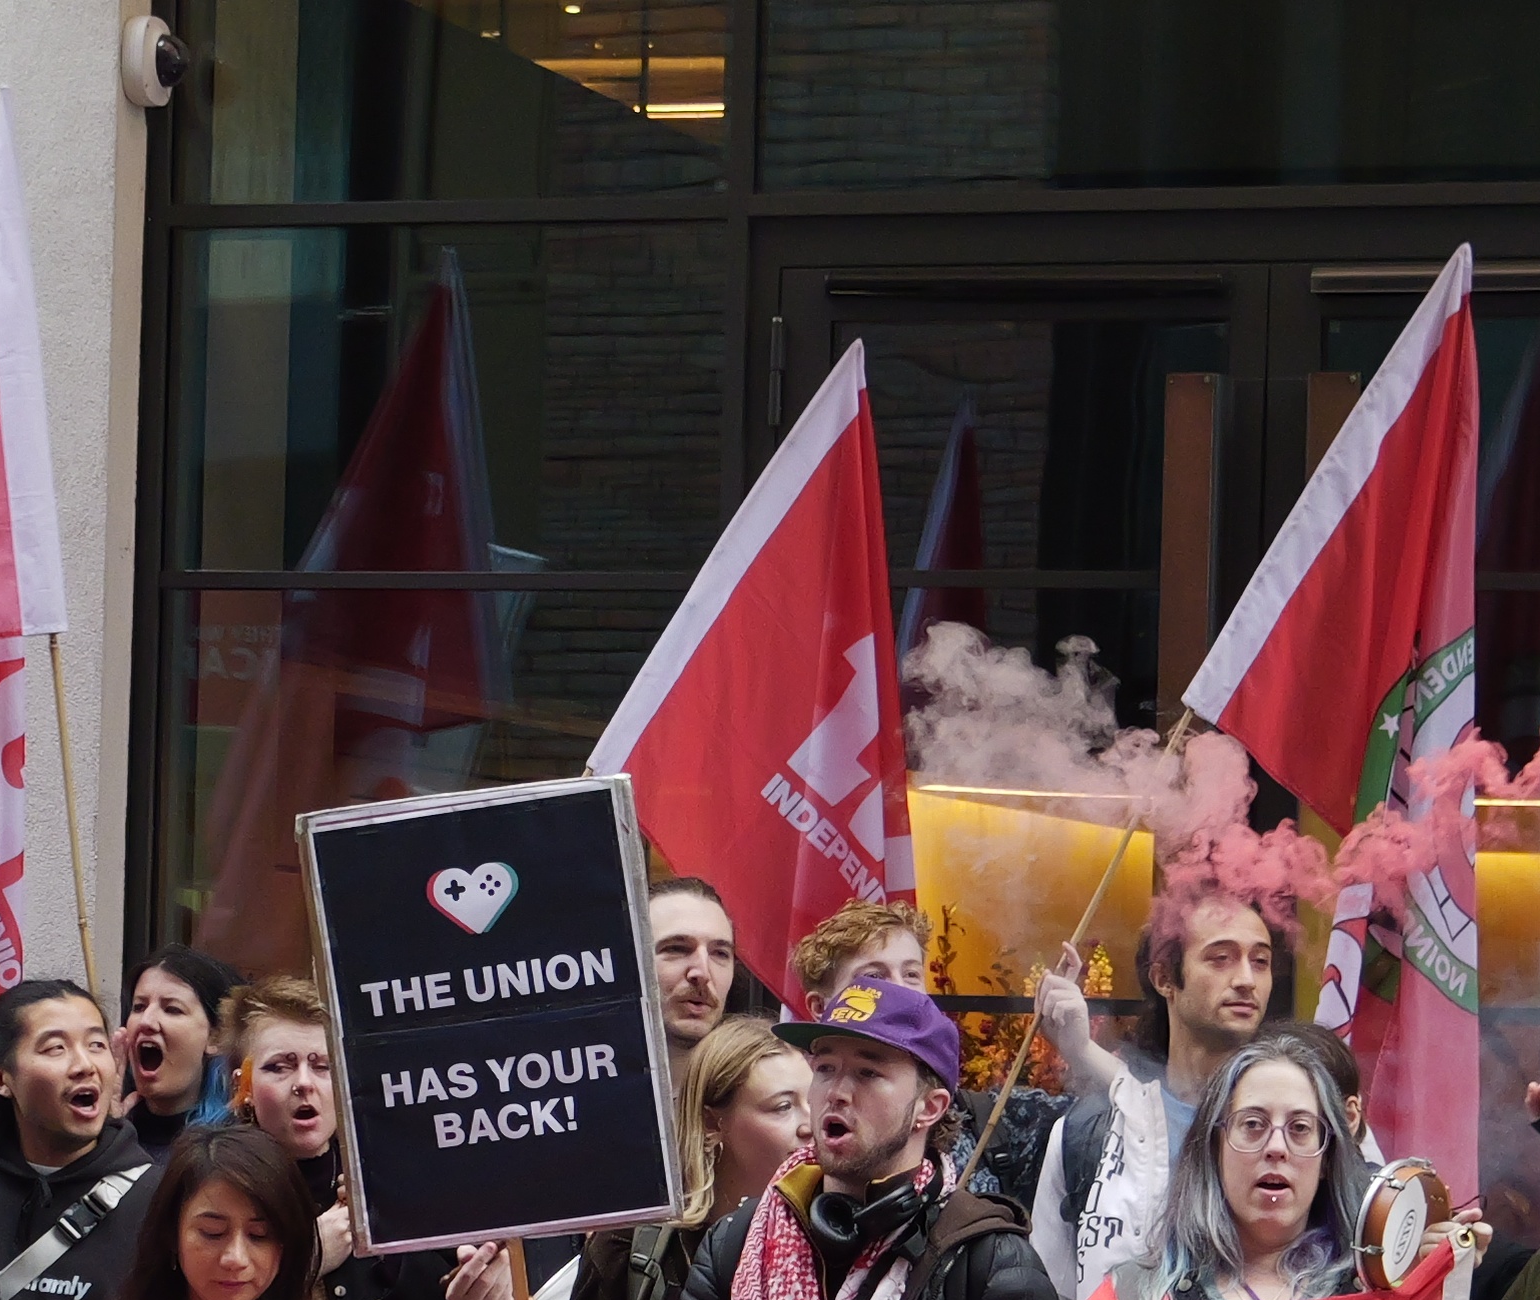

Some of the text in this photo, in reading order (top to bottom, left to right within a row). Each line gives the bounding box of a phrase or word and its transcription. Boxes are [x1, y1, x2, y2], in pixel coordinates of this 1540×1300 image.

[360, 947, 616, 1017] THE UNION
[381, 1043, 618, 1108] HAS YOUR
[433, 1096, 579, 1149] BACK!
